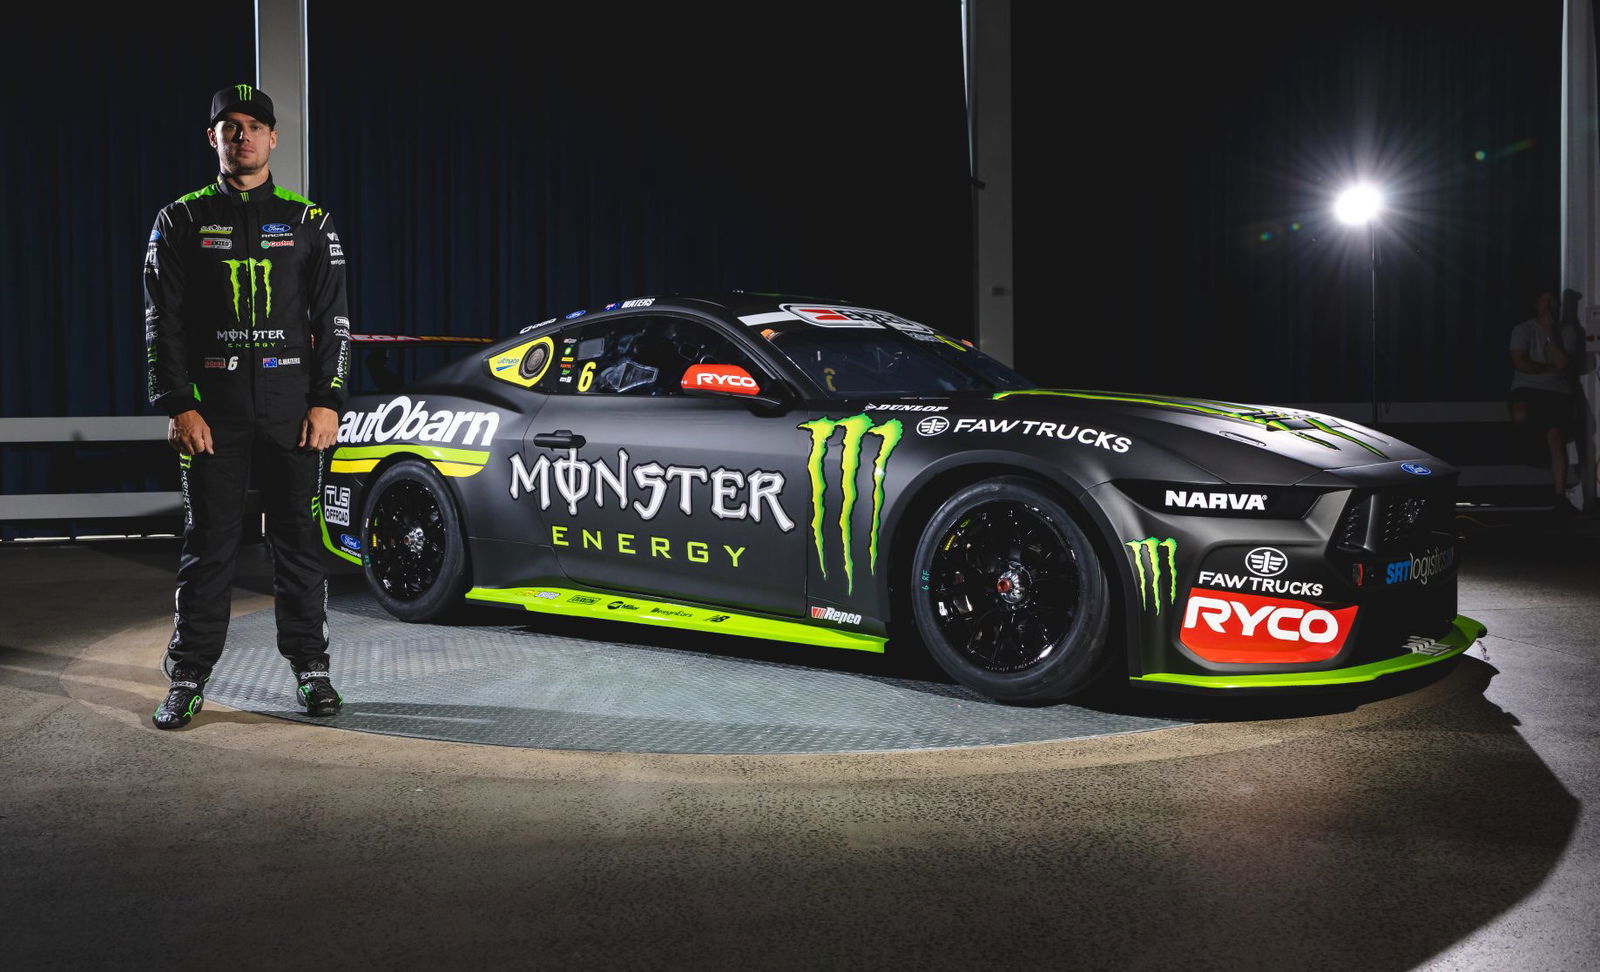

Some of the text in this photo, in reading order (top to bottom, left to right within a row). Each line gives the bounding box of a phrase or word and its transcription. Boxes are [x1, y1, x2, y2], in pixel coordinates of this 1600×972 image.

[621, 298, 656, 308] WATERS
[216, 328, 285, 341] MONSTER
[227, 356, 239, 370] 6
[577, 361, 597, 393] 6
[696, 372, 756, 388] RYCO
[875, 403, 950, 412] DUNLOP
[953, 418, 1133, 454] FAW TRUCKS
[508, 447, 796, 532] MONSTER
[551, 525, 746, 568] ENERGY
[1198, 571, 1324, 597] FAW TRUCKS
[823, 606, 862, 625] Repco
[1183, 595, 1339, 644] RYCO
